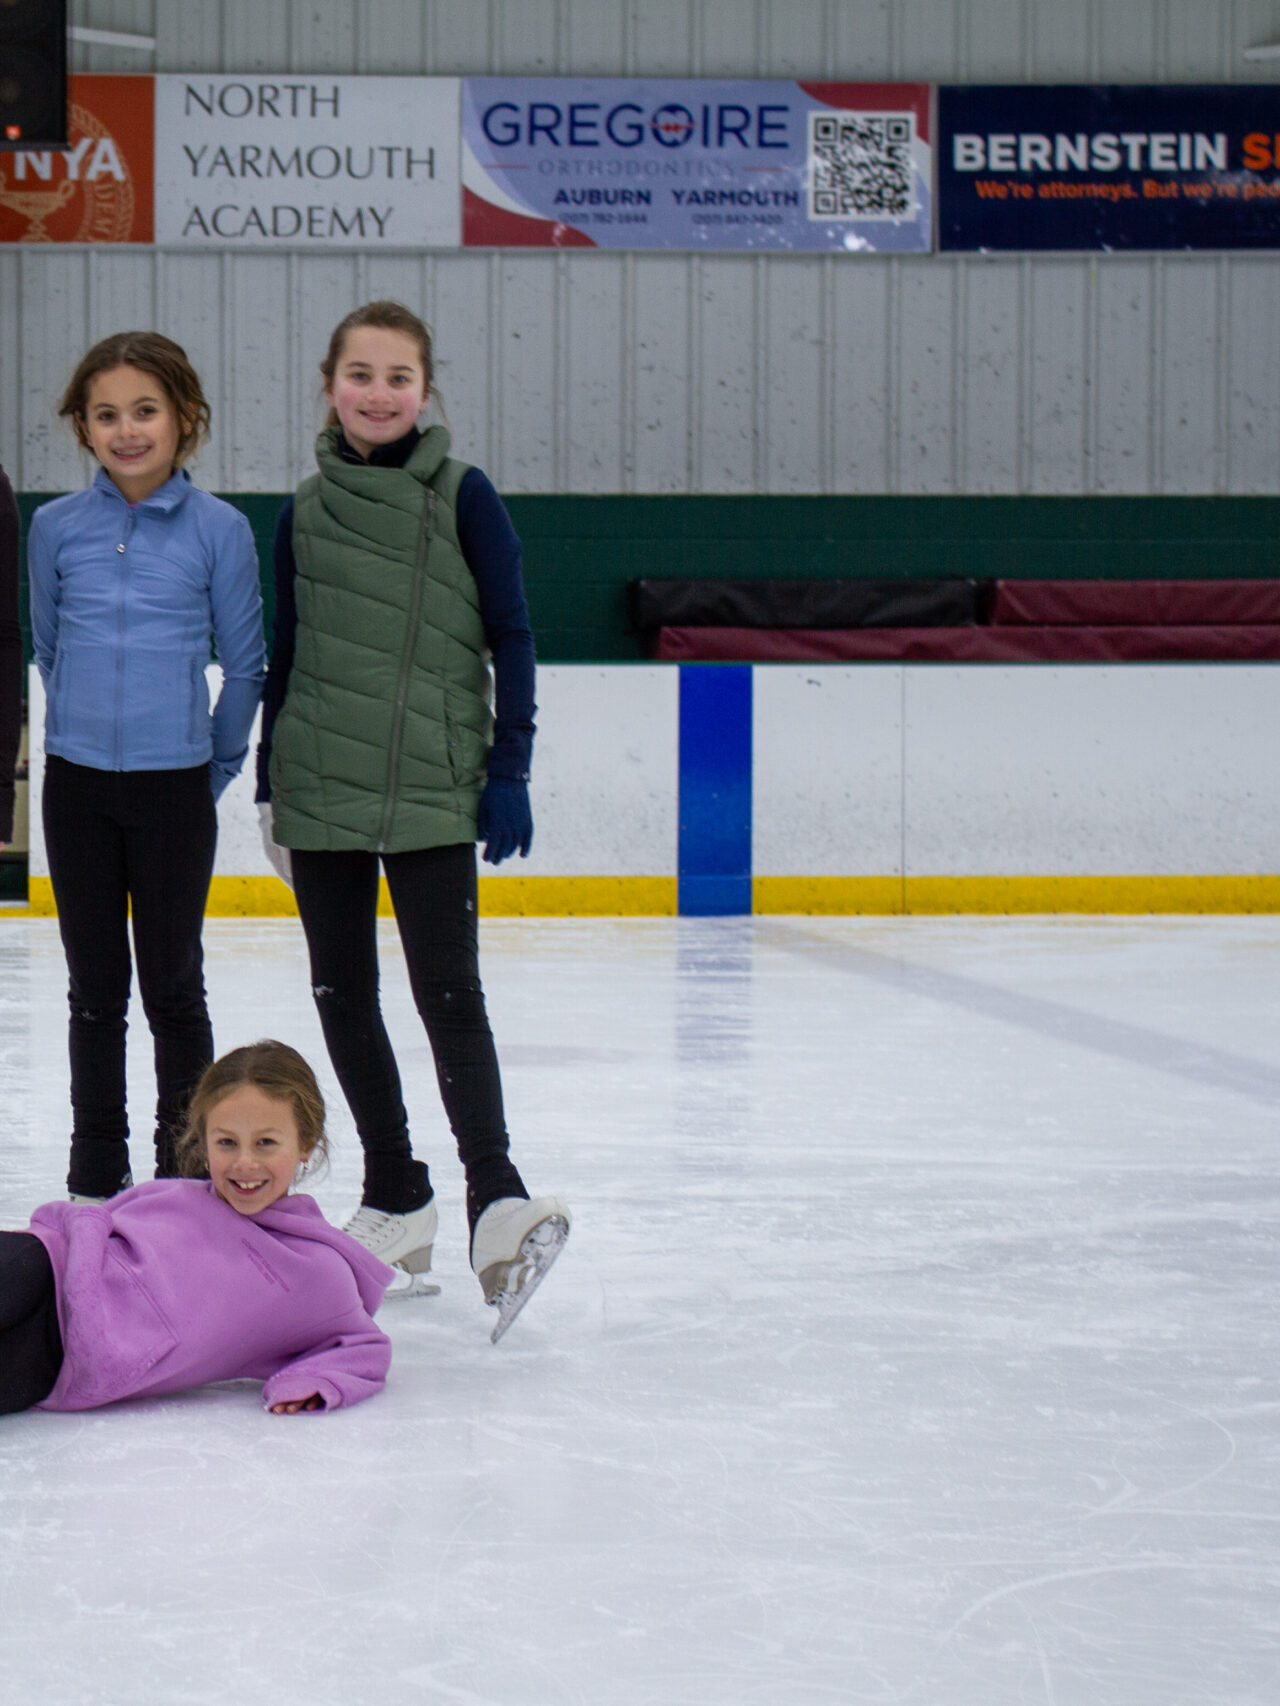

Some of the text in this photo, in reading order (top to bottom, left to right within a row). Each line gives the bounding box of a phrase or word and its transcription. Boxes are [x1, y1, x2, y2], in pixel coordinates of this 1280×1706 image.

[183, 84, 340, 118] NORTH
[482, 102, 790, 149] GREGOIRE
[14, 137, 126, 181] NYA
[182, 144, 436, 180] YARMOUTH
[952, 132, 1280, 172] BERNSTEIN S
[552, 188, 800, 208] AUBURN YARMOUTH
[975, 180, 1034, 199] We're
[1037, 180, 1139, 202] attorneys.
[1142, 179, 1179, 198] But
[1182, 179, 1239, 198] we're
[181, 205, 394, 238] ACADEMY
